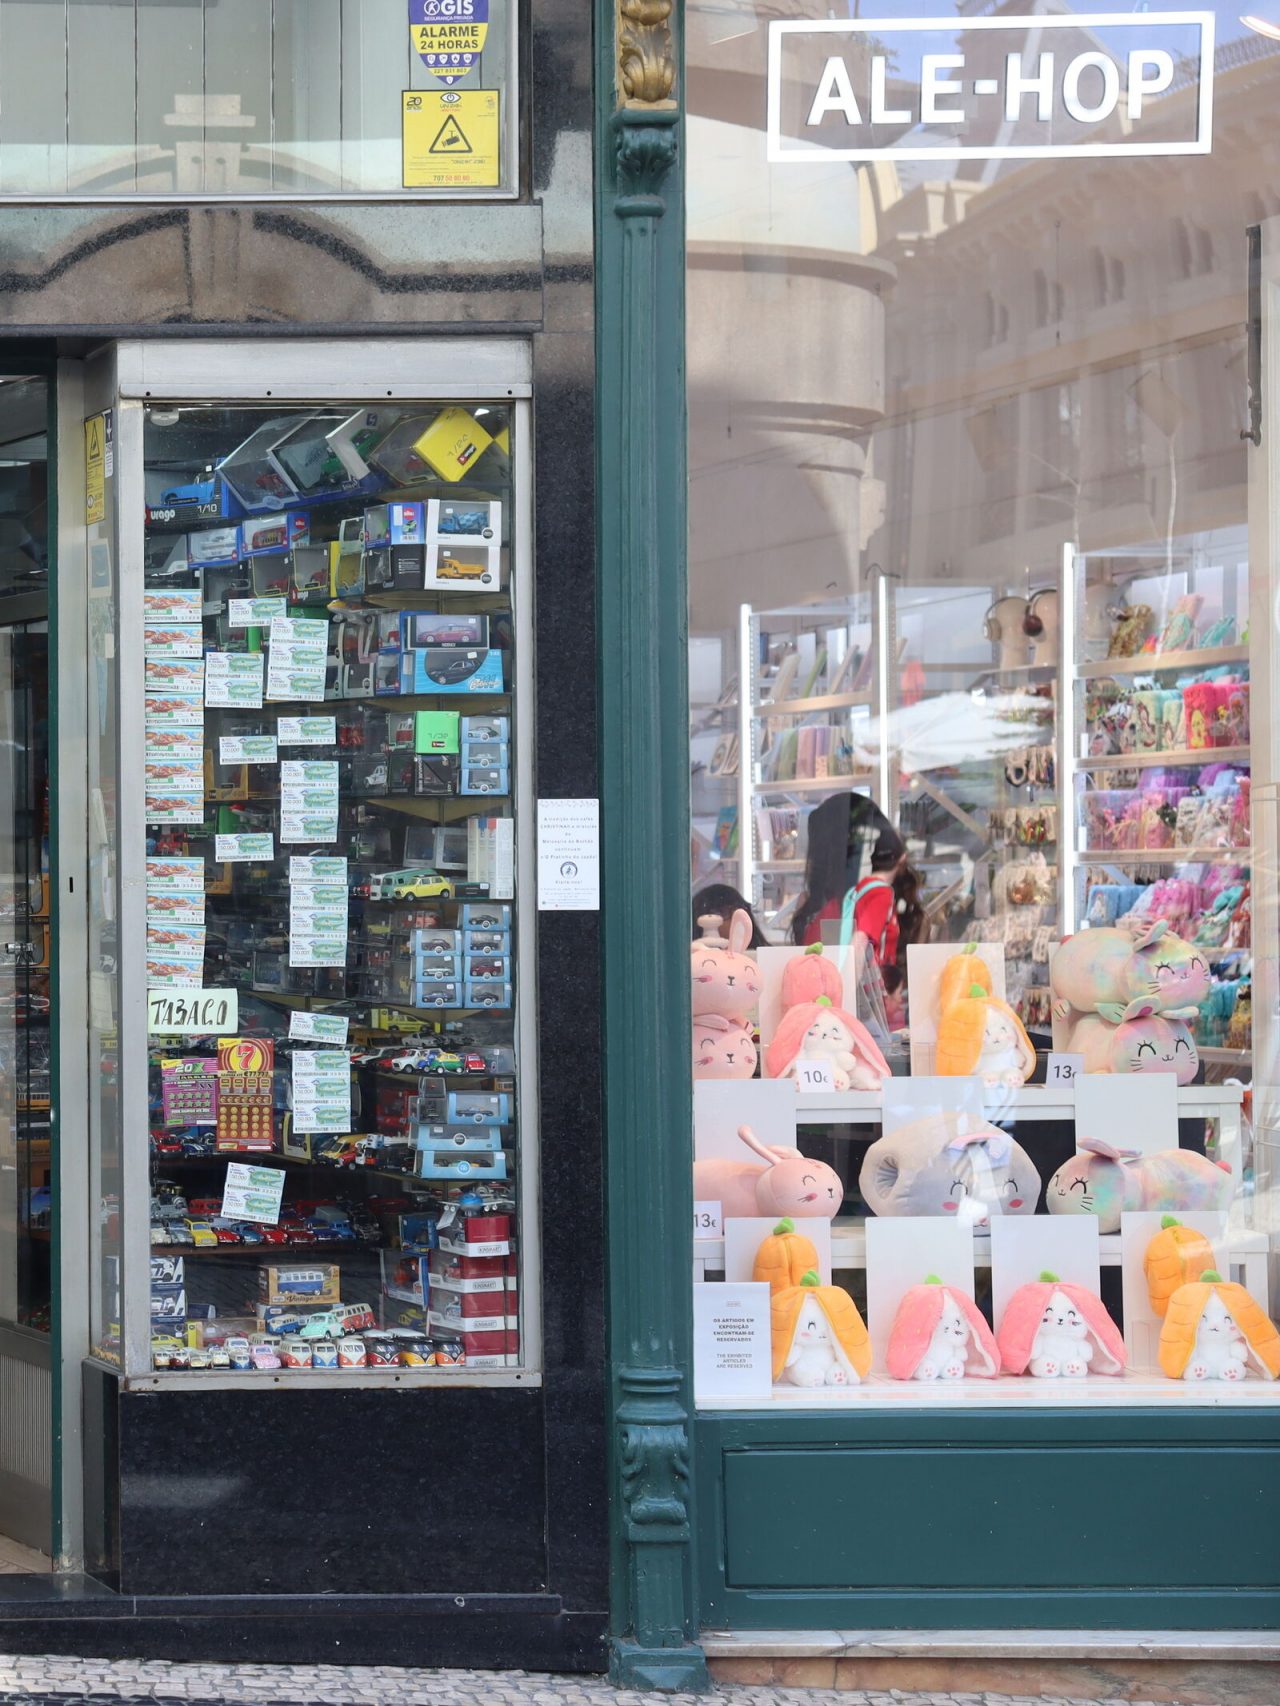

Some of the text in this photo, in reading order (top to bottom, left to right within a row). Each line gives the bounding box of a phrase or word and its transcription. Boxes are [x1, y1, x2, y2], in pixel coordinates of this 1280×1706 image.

[419, 25, 479, 39] ALARME
[420, 39, 479, 50] 24 HORAS
[806, 50, 1174, 125] ALE-HOP
[150, 998, 229, 1026] TABACO
[236, 1045, 257, 1070] 7
[804, 1071, 829, 1084] 10€
[694, 1214, 716, 1228] 13€
